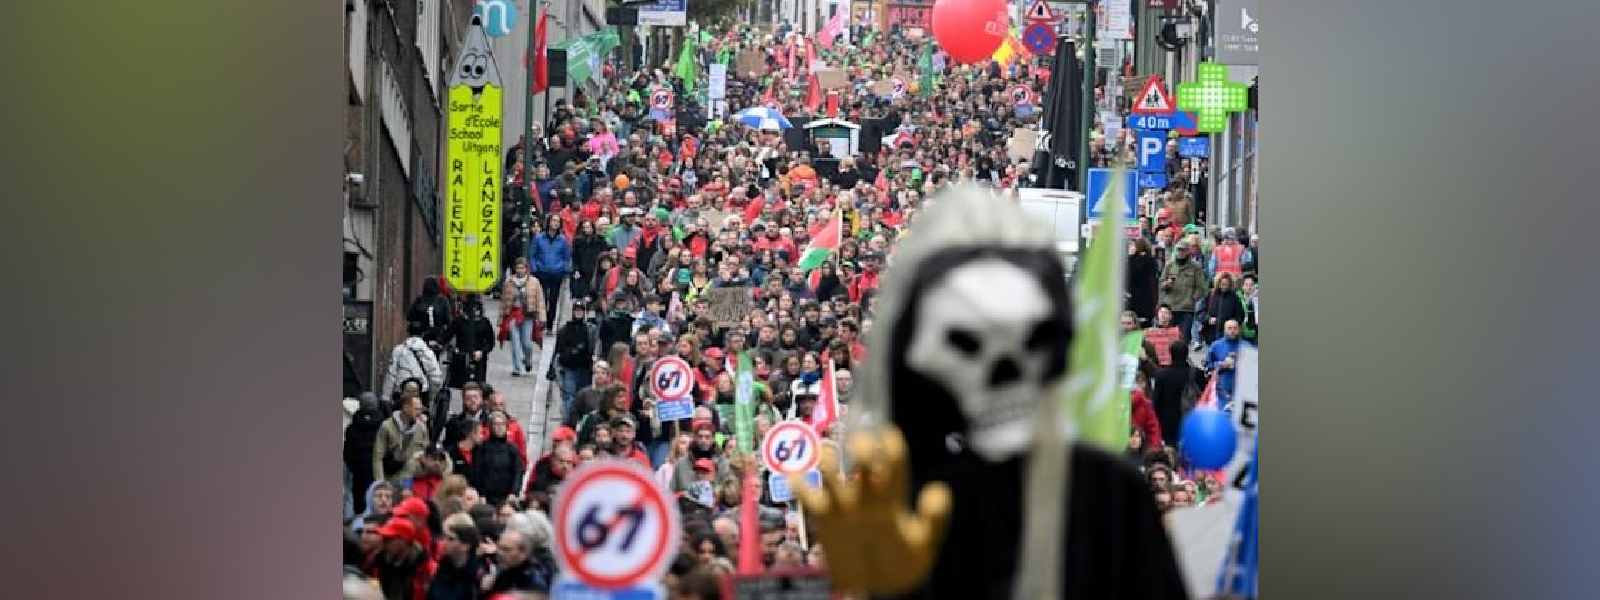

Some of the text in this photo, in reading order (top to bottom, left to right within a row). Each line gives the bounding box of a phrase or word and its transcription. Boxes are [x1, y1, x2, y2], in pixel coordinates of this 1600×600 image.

[450, 128, 483, 139] School
[463, 141, 500, 156] Uitgang
[1141, 137, 1163, 168] P
[450, 158, 463, 278] RALENTIR
[480, 160, 496, 278] LANGZAAM
[658, 370, 682, 390] 67
[775, 439, 807, 462] 67
[577, 502, 646, 552] 67
